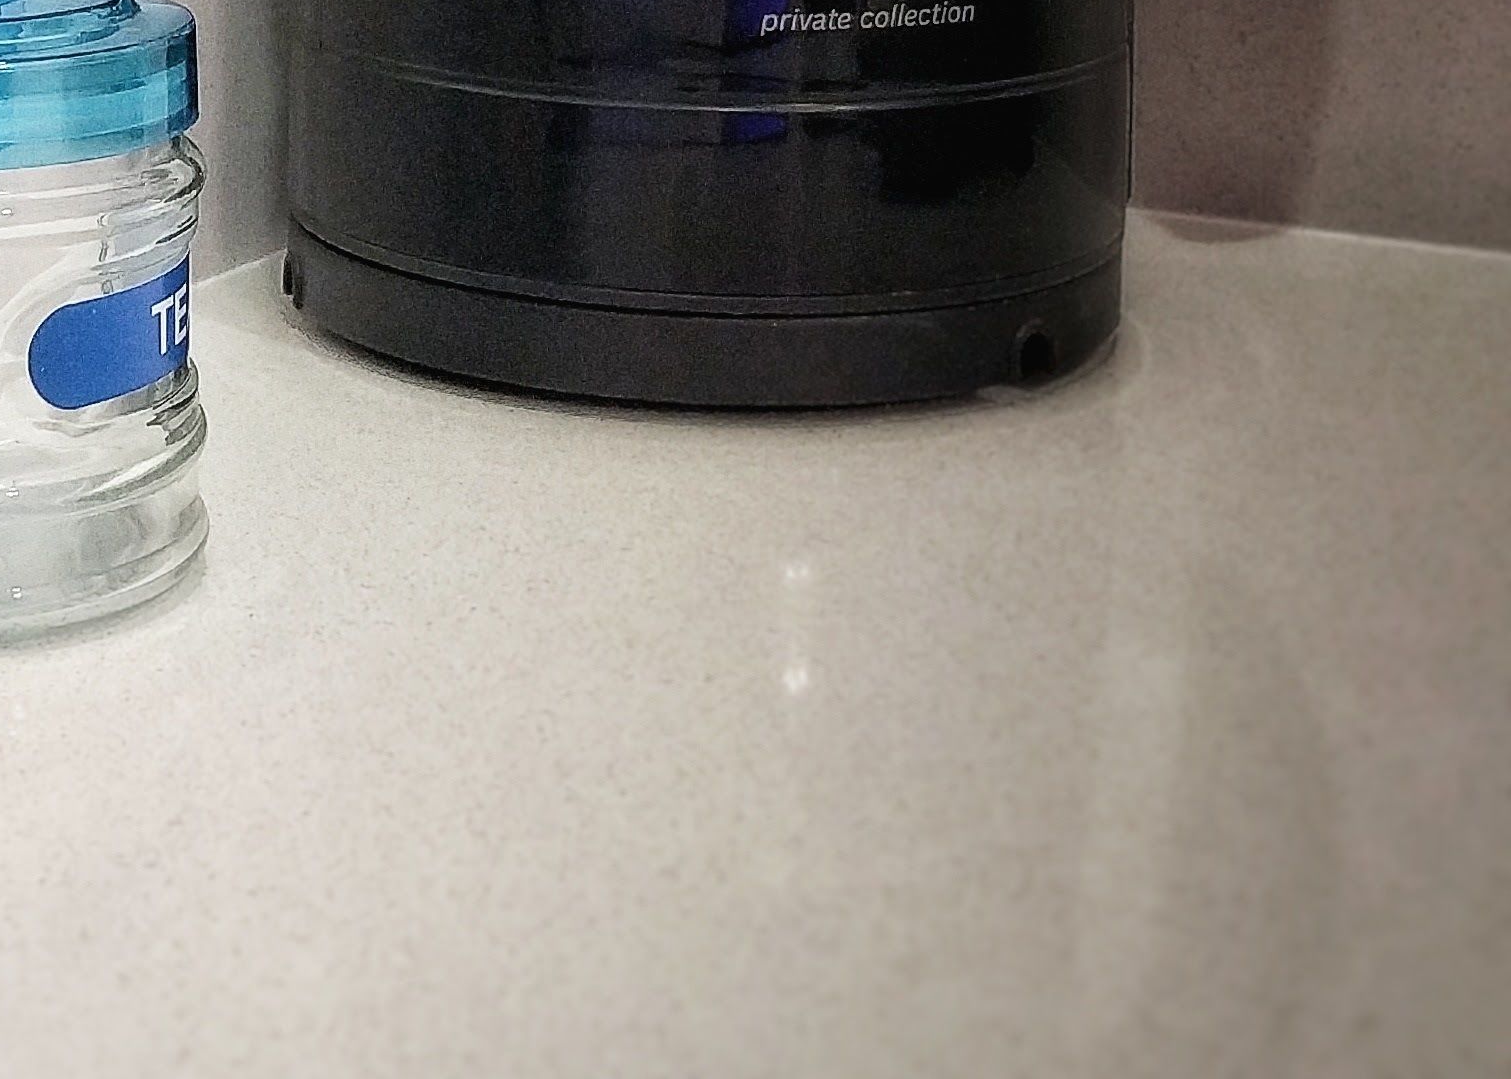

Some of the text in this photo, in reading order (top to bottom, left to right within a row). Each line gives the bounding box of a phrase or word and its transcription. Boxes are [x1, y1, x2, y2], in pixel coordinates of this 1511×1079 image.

[759, 1, 976, 37] private collection
[150, 282, 189, 355] TE
